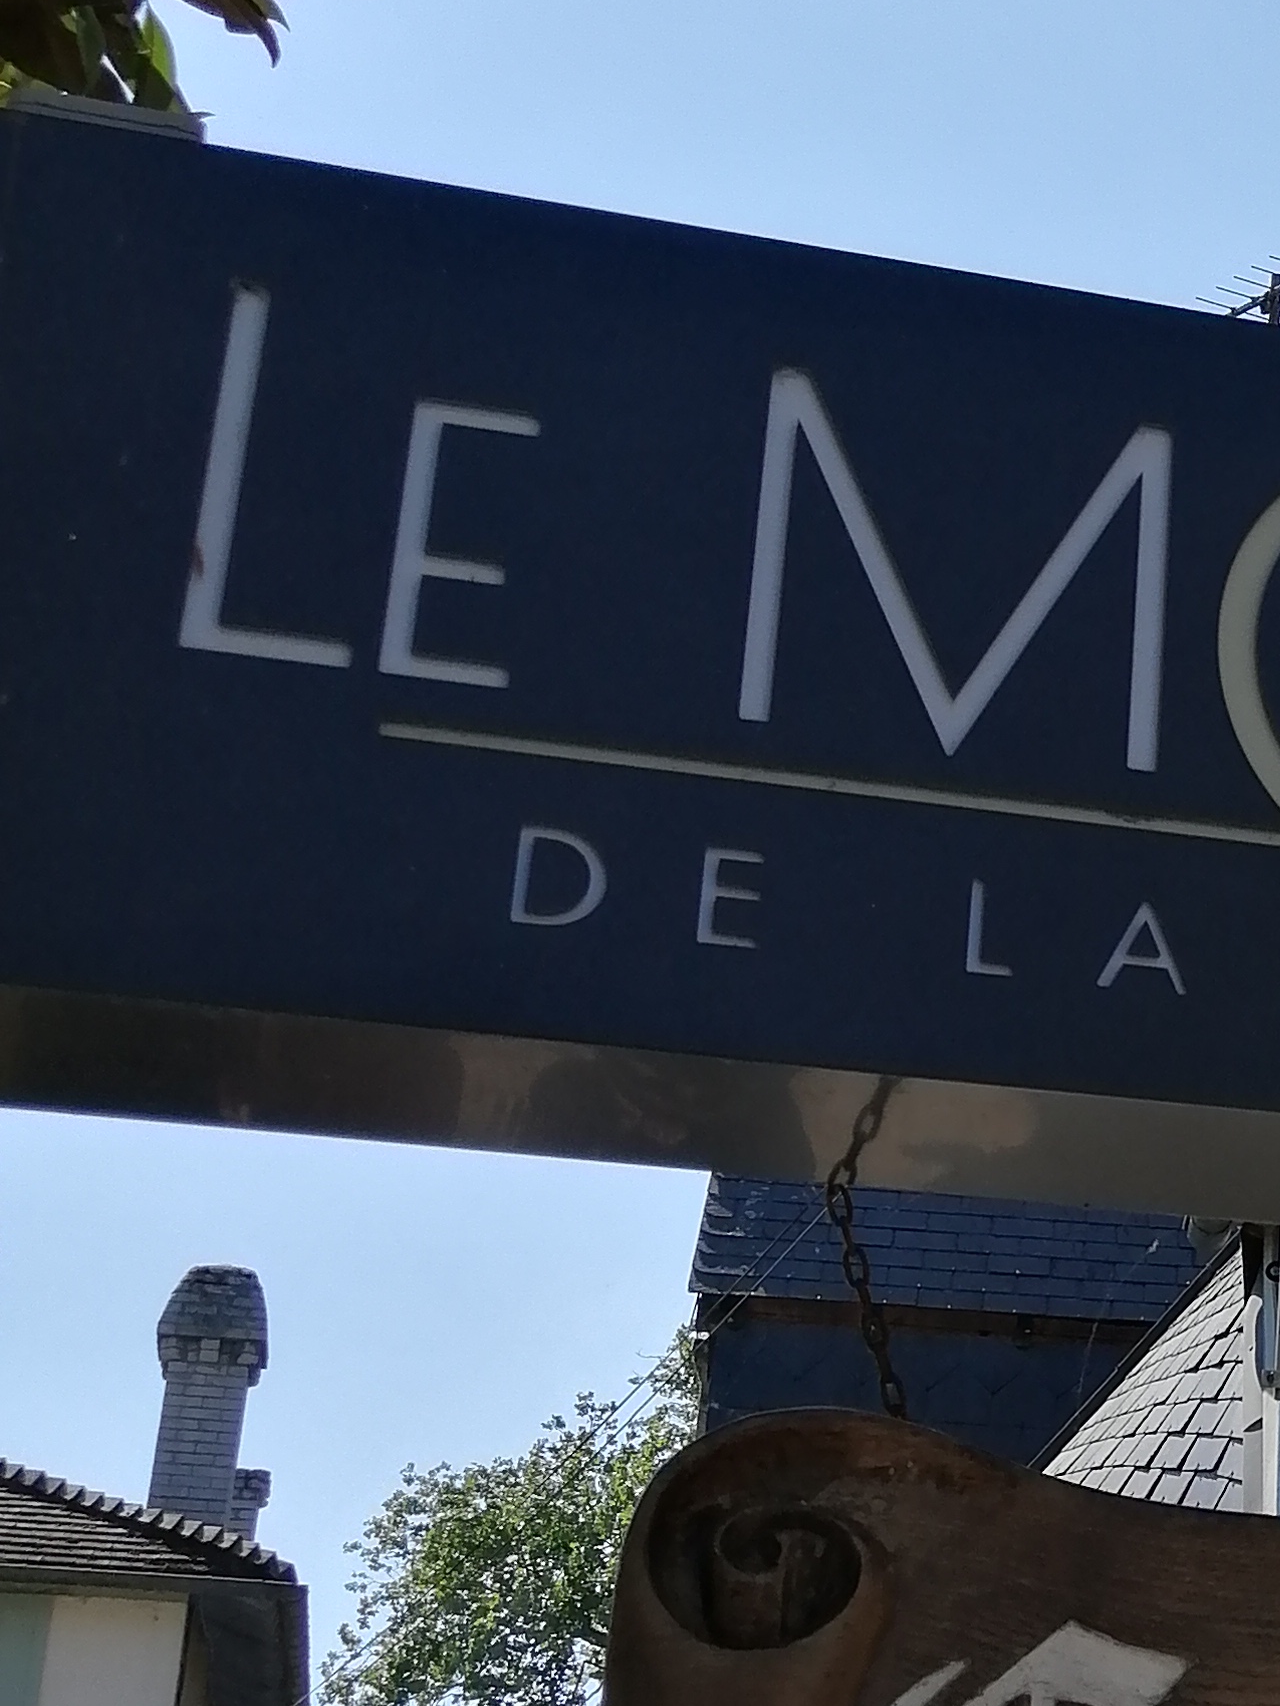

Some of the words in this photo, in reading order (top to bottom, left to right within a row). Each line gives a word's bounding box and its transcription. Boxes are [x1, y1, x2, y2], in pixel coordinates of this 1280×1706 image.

[179, 279, 542, 690] LE
[509, 824, 764, 951] DE
[964, 877, 1188, 998] LA
